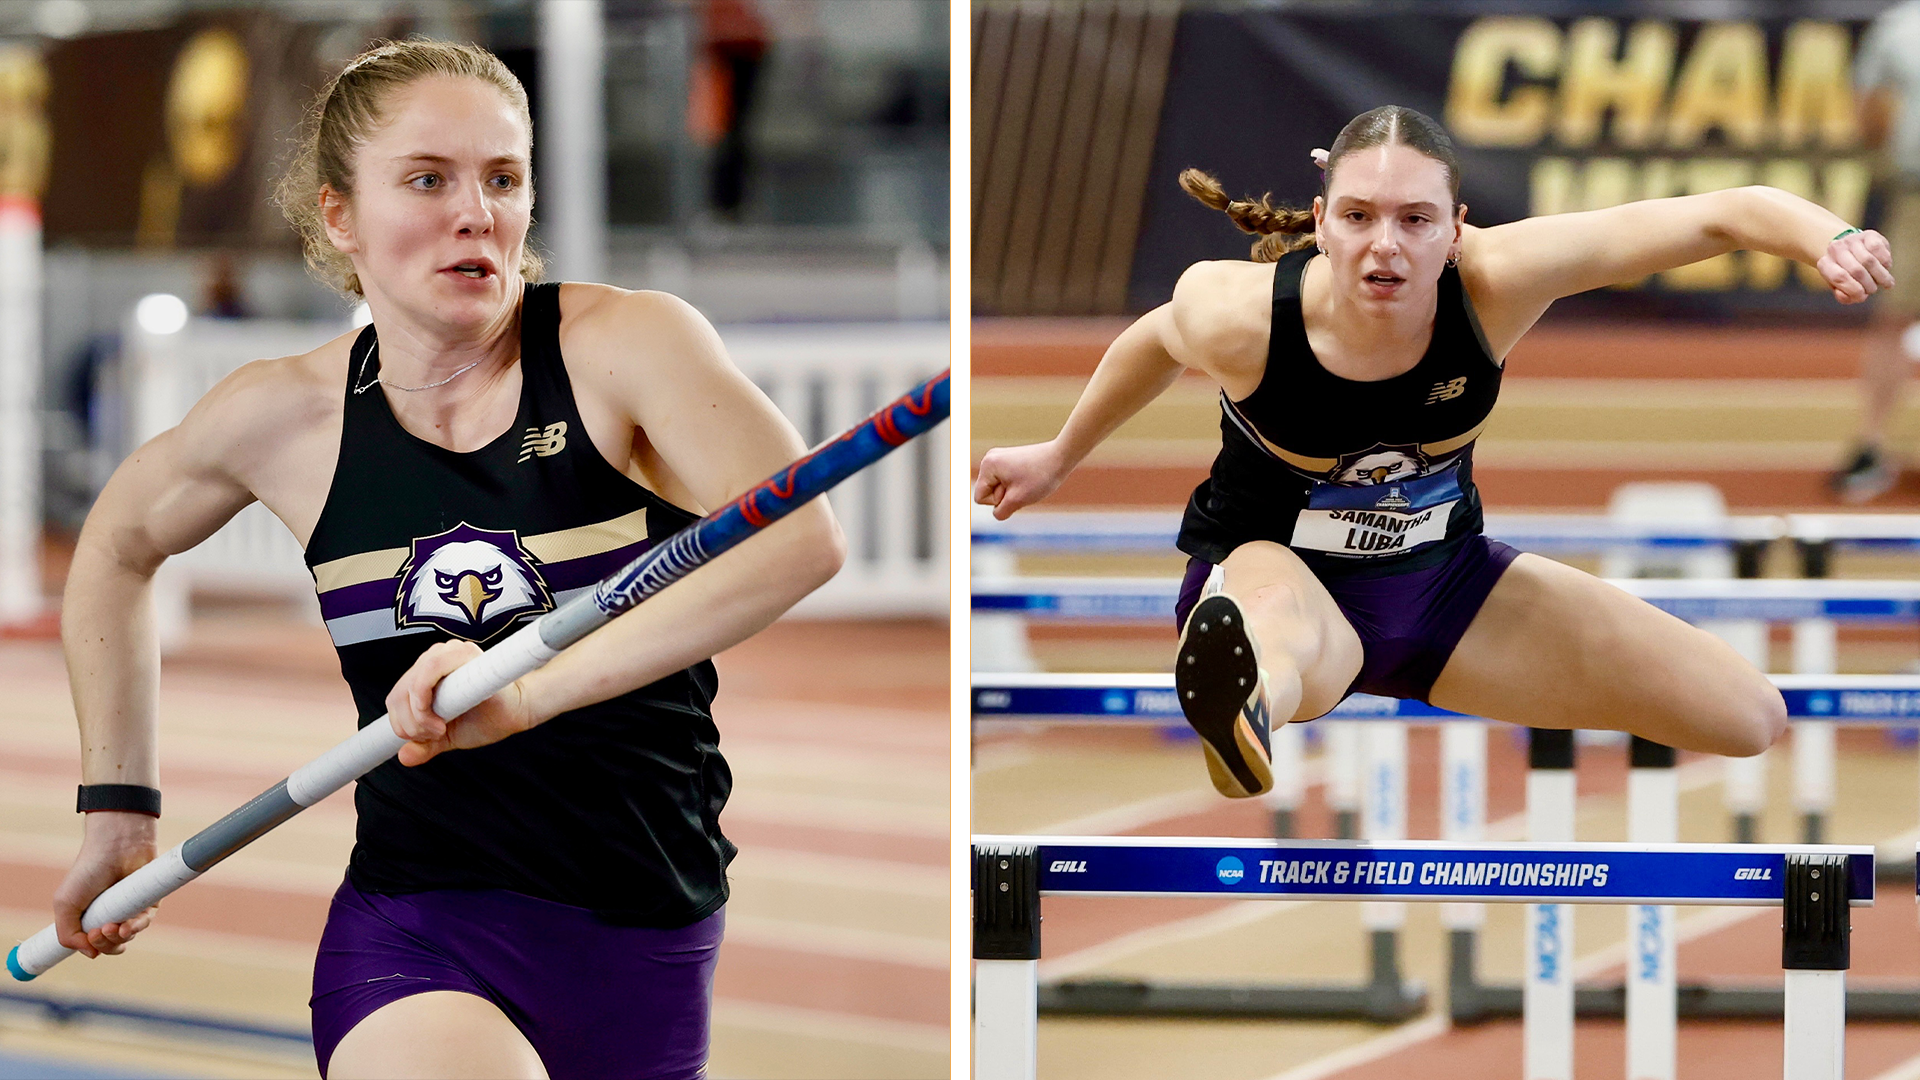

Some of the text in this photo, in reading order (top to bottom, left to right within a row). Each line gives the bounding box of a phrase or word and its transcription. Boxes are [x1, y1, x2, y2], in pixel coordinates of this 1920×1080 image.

[1329, 509, 1432, 534] SAMANTHA
[1344, 528, 1406, 551] LUBA
[1049, 860, 1088, 873] GILL
[1218, 869, 1244, 879] NCAA
[1258, 860, 1609, 888] TRACK & FIELD CHAMPIONSHIPS
[1734, 868, 1772, 880] GILL
